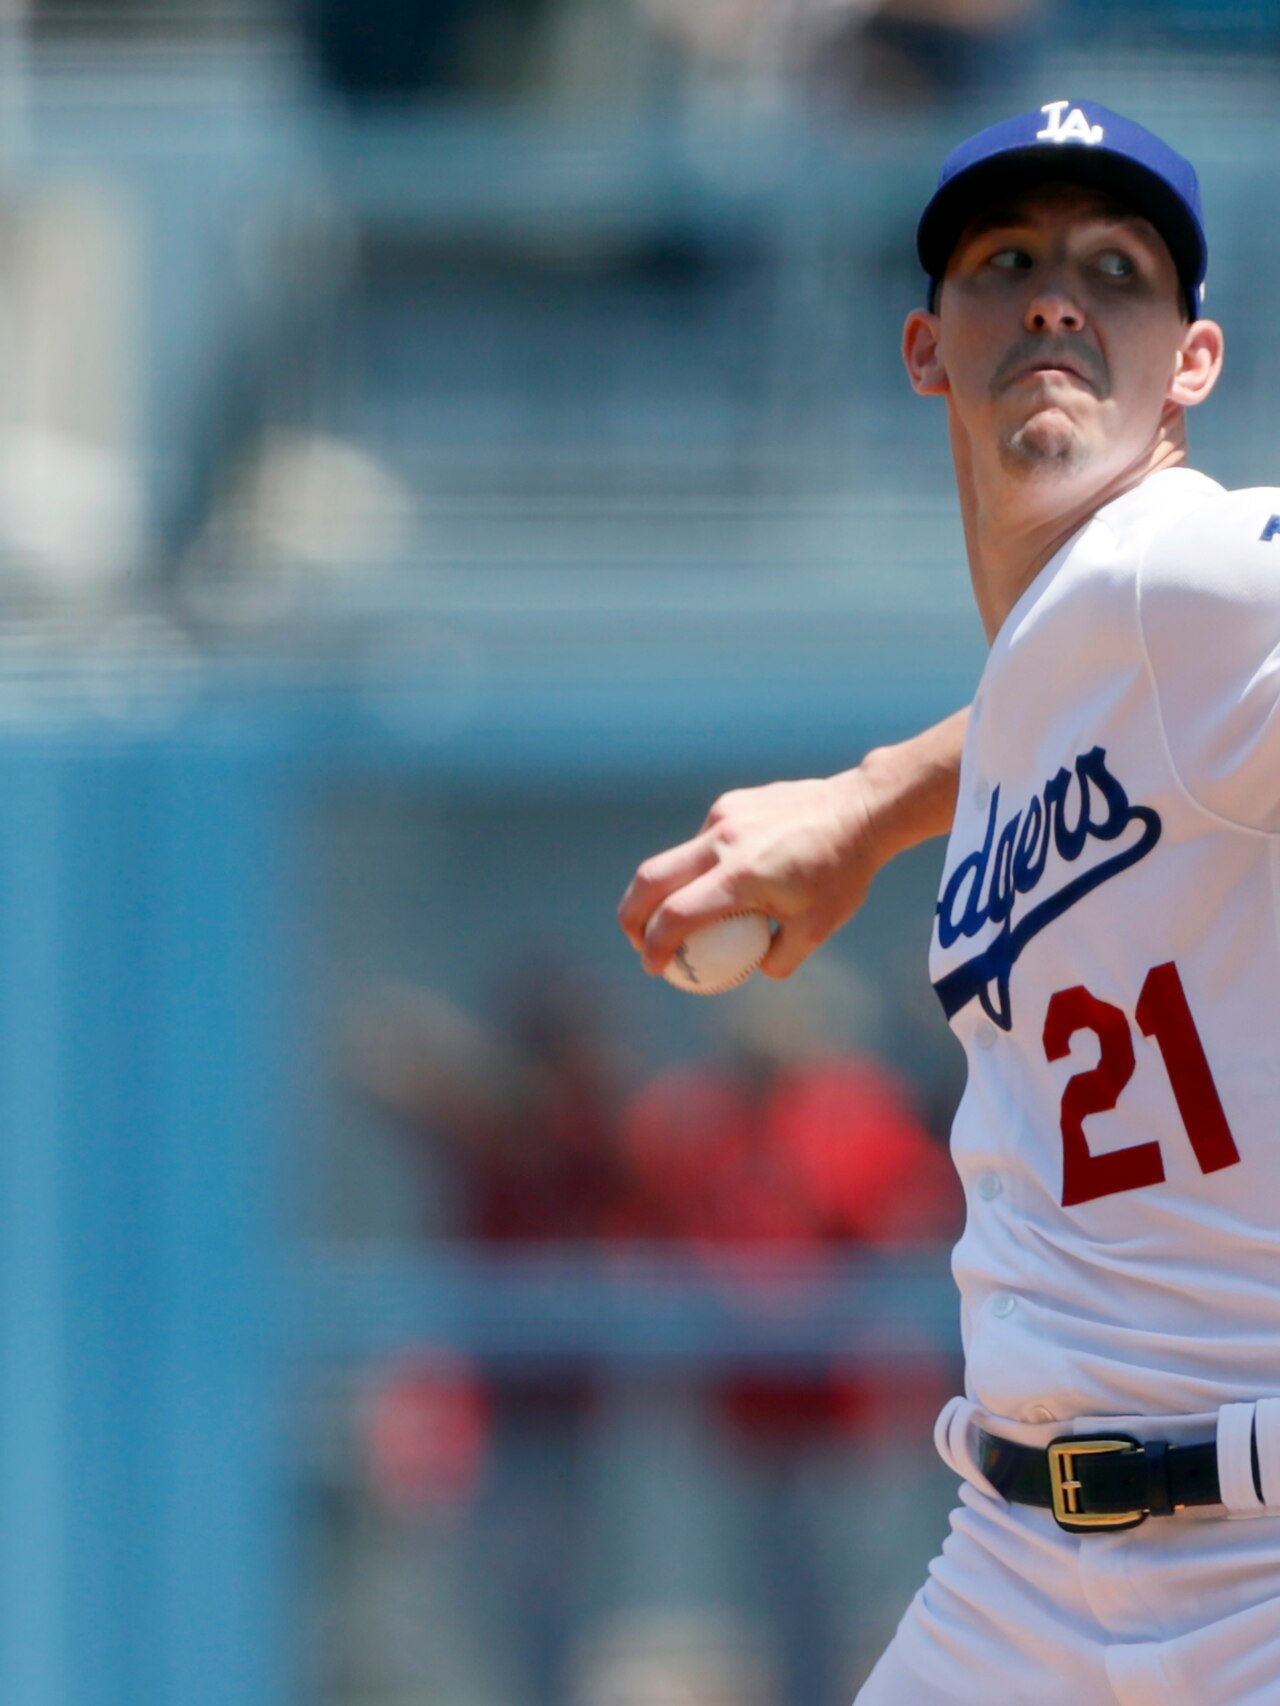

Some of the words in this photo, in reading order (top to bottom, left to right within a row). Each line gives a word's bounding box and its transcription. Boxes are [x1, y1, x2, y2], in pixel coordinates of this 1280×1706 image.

[1036, 100, 1104, 144] LA
[934, 745, 1162, 1032] dgers
[1042, 961, 1241, 1207] 21
